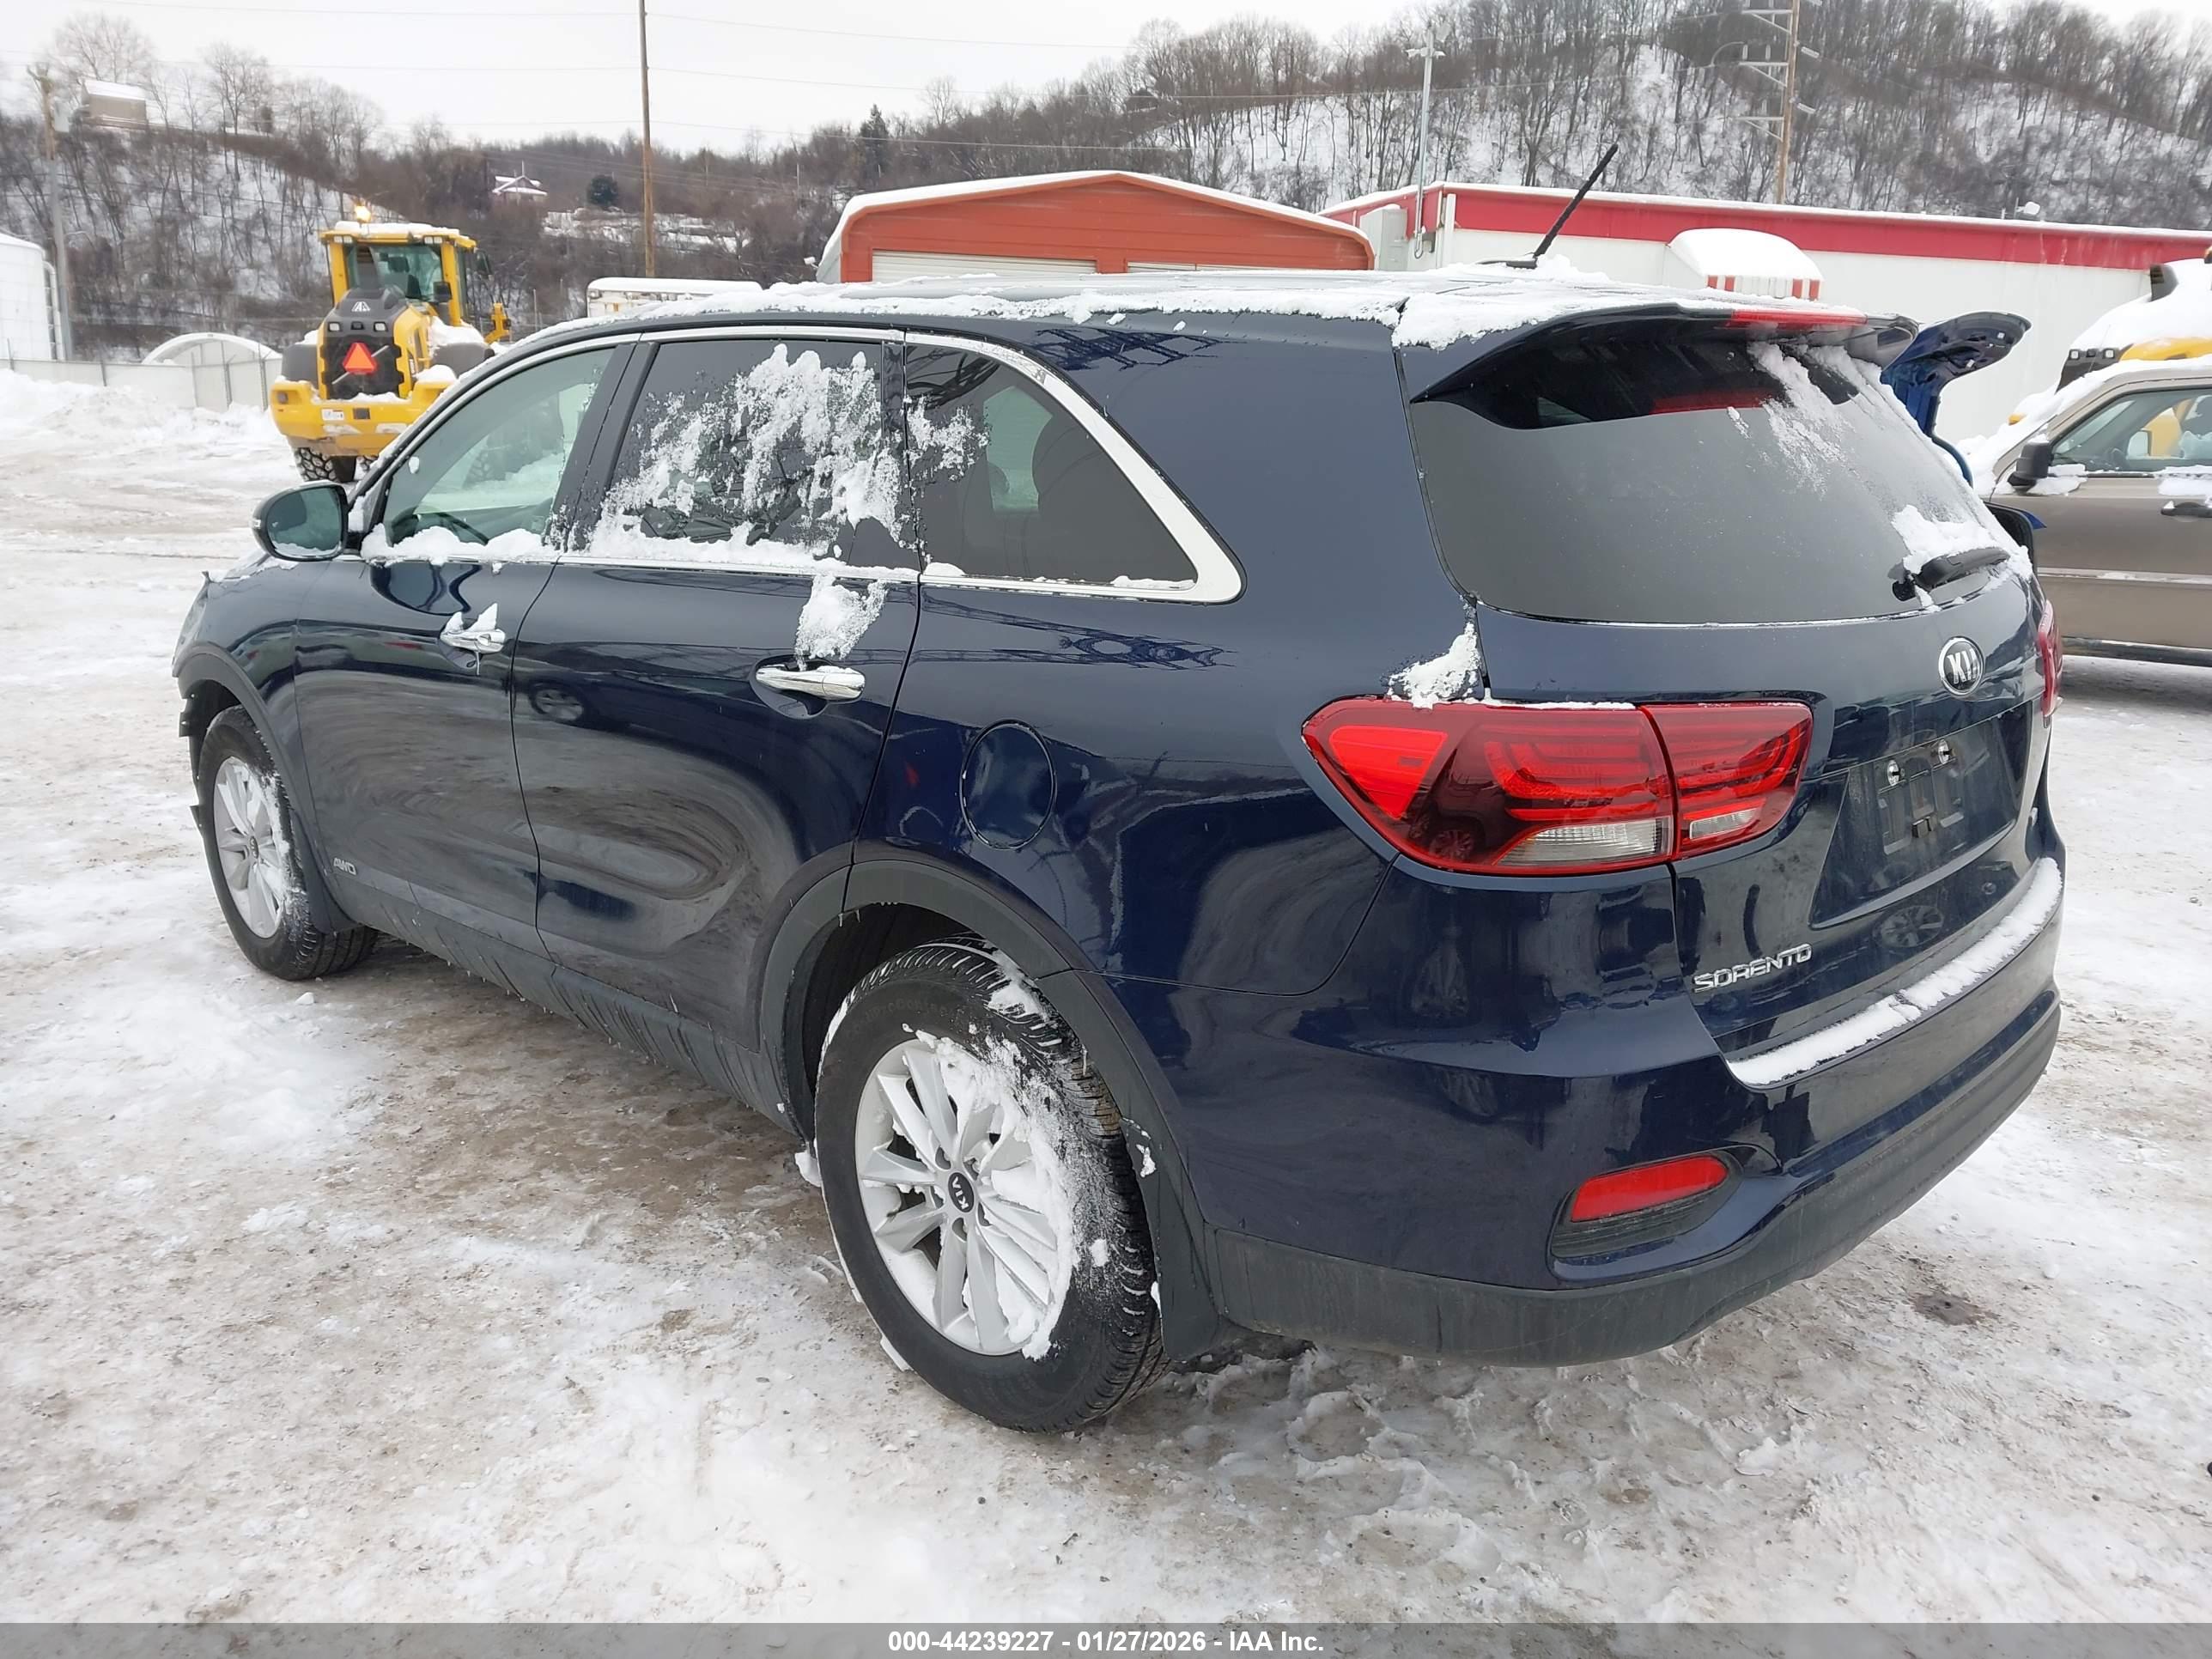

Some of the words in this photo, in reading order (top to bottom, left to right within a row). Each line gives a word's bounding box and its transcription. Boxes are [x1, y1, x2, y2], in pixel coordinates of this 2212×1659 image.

[1947, 647, 1980, 684] KIA
[333, 857, 357, 876] AWD
[1693, 943, 1812, 993] SORENTO
[951, 1176, 969, 1210] KIA
